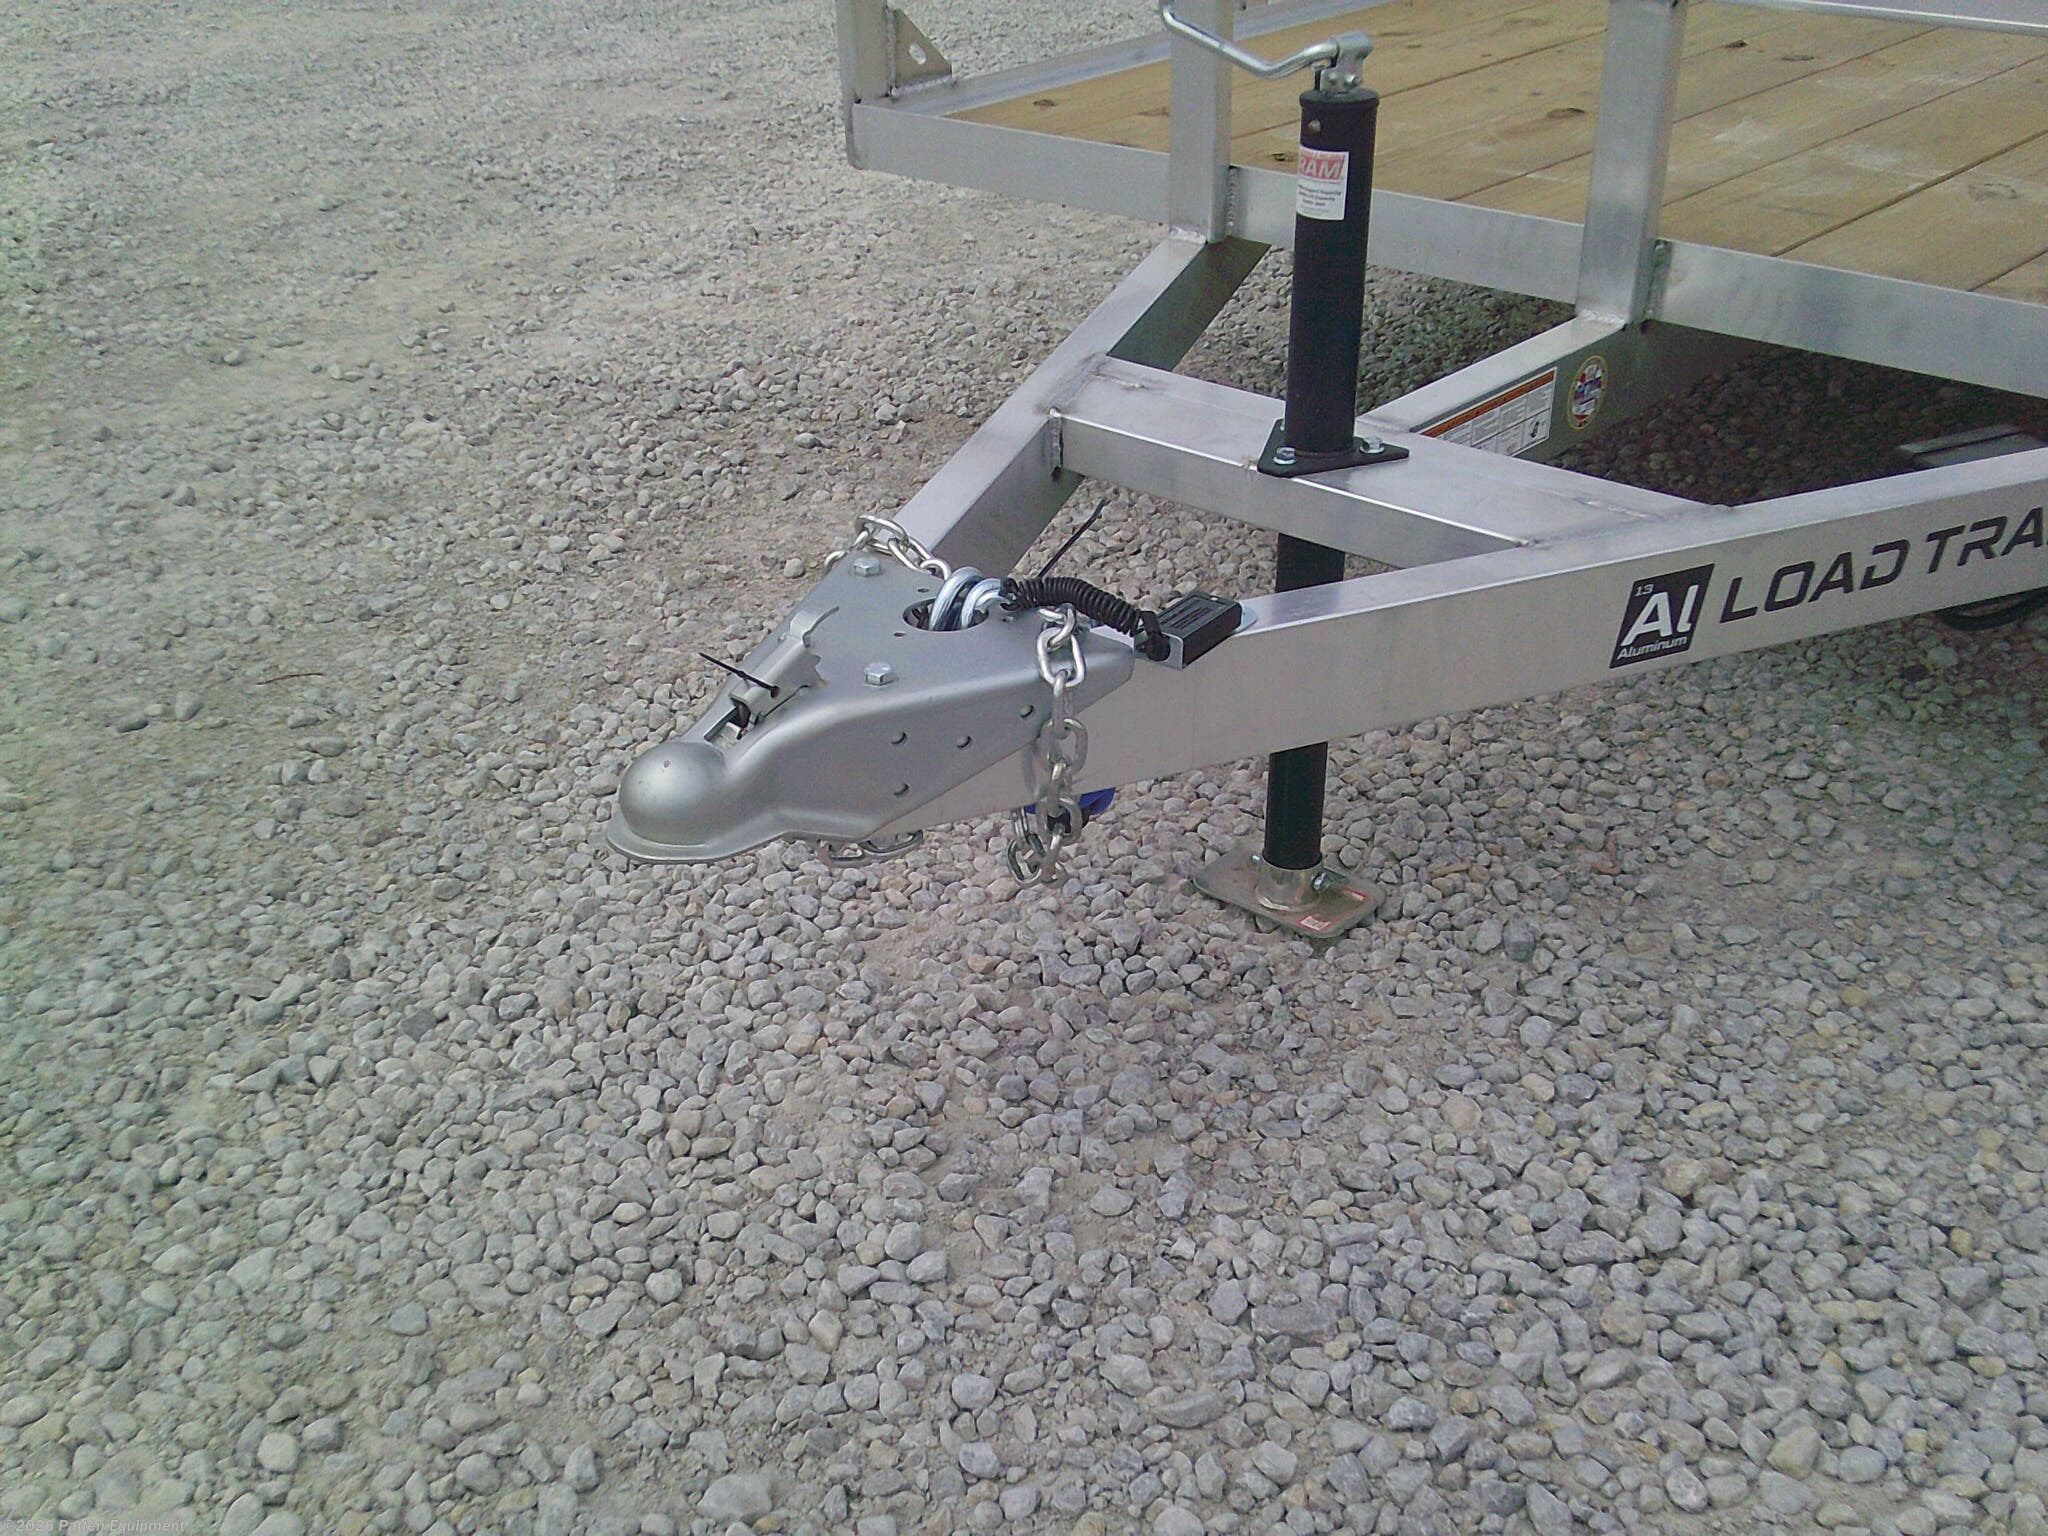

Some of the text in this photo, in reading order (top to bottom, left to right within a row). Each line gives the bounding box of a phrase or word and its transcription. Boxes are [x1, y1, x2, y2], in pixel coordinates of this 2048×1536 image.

[1719, 506, 2048, 624] LOAD TRA
[1634, 583, 1654, 597] 13
[1616, 636, 1688, 660] Aluminum
